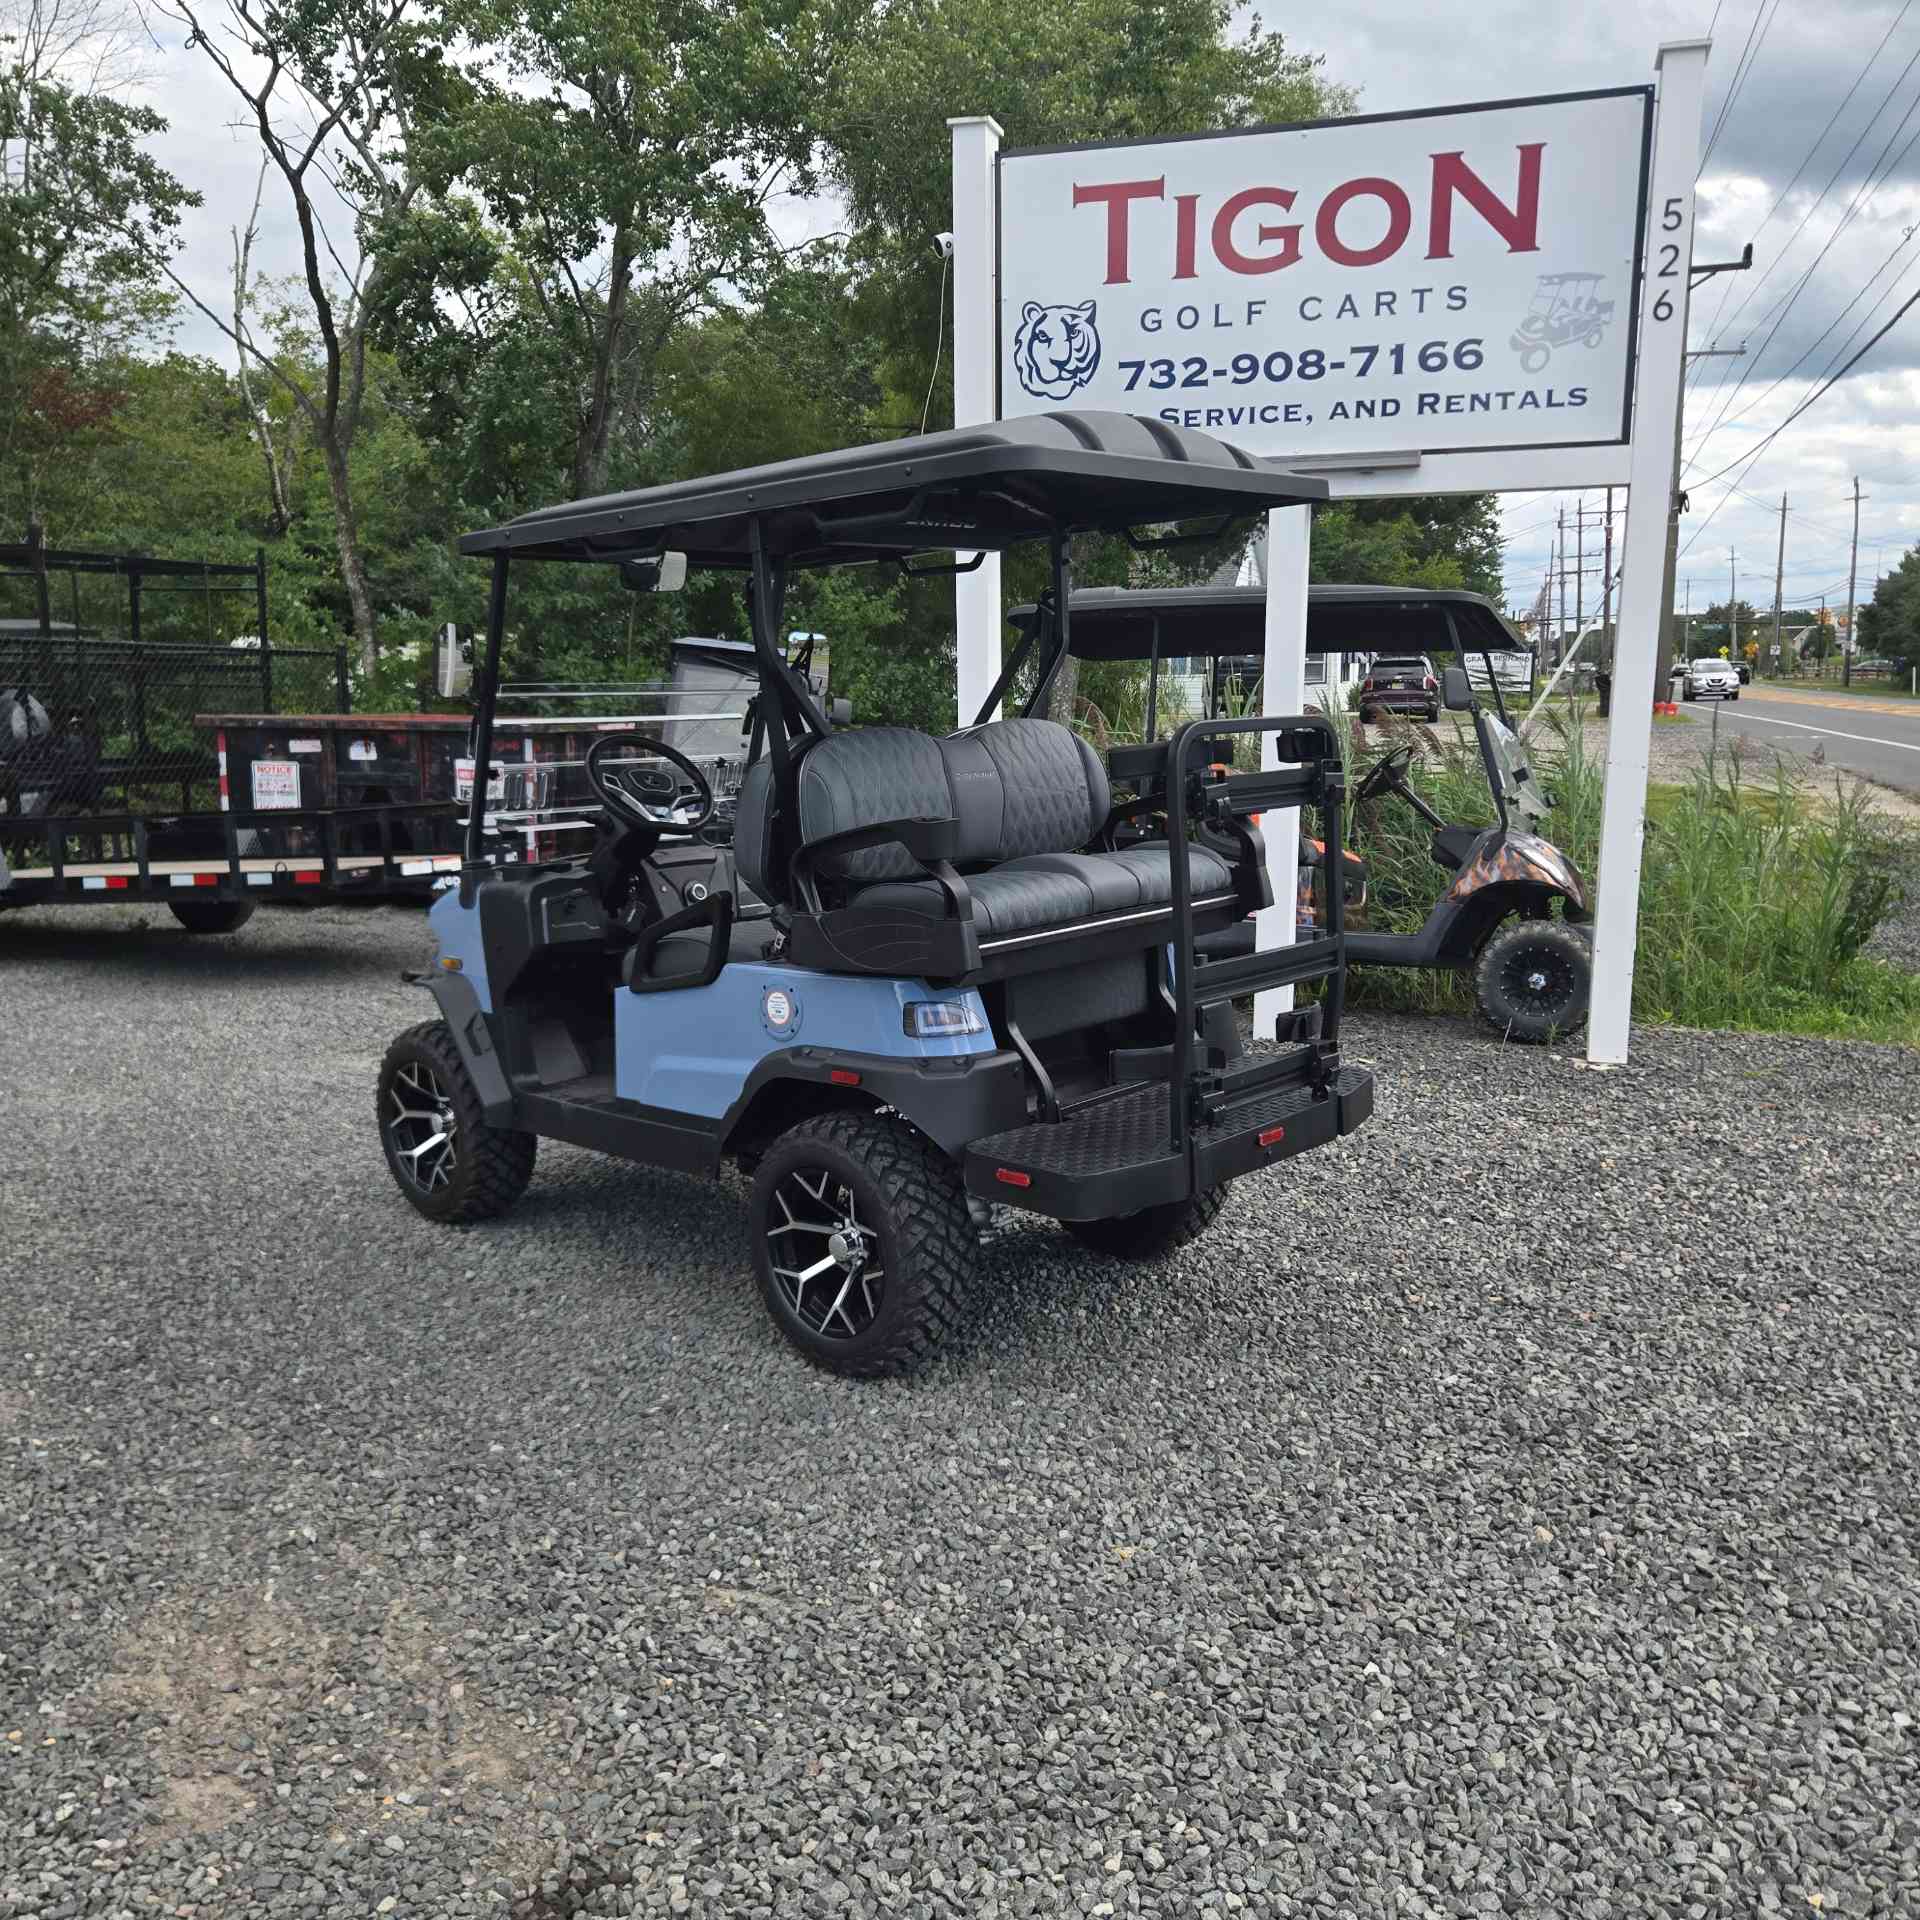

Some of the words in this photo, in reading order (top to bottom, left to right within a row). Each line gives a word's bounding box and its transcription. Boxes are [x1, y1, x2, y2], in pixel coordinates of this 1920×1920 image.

[1071, 142, 1546, 284] TIGON
[1141, 299, 1267, 333] GOLF
[1299, 285, 1468, 323] CARTS
[1117, 338, 1484, 392] 732-908-7166
[1159, 402, 1313, 427] SERVICE,
[1328, 398, 1401, 421] AND
[1417, 387, 1588, 416] RENTALS
